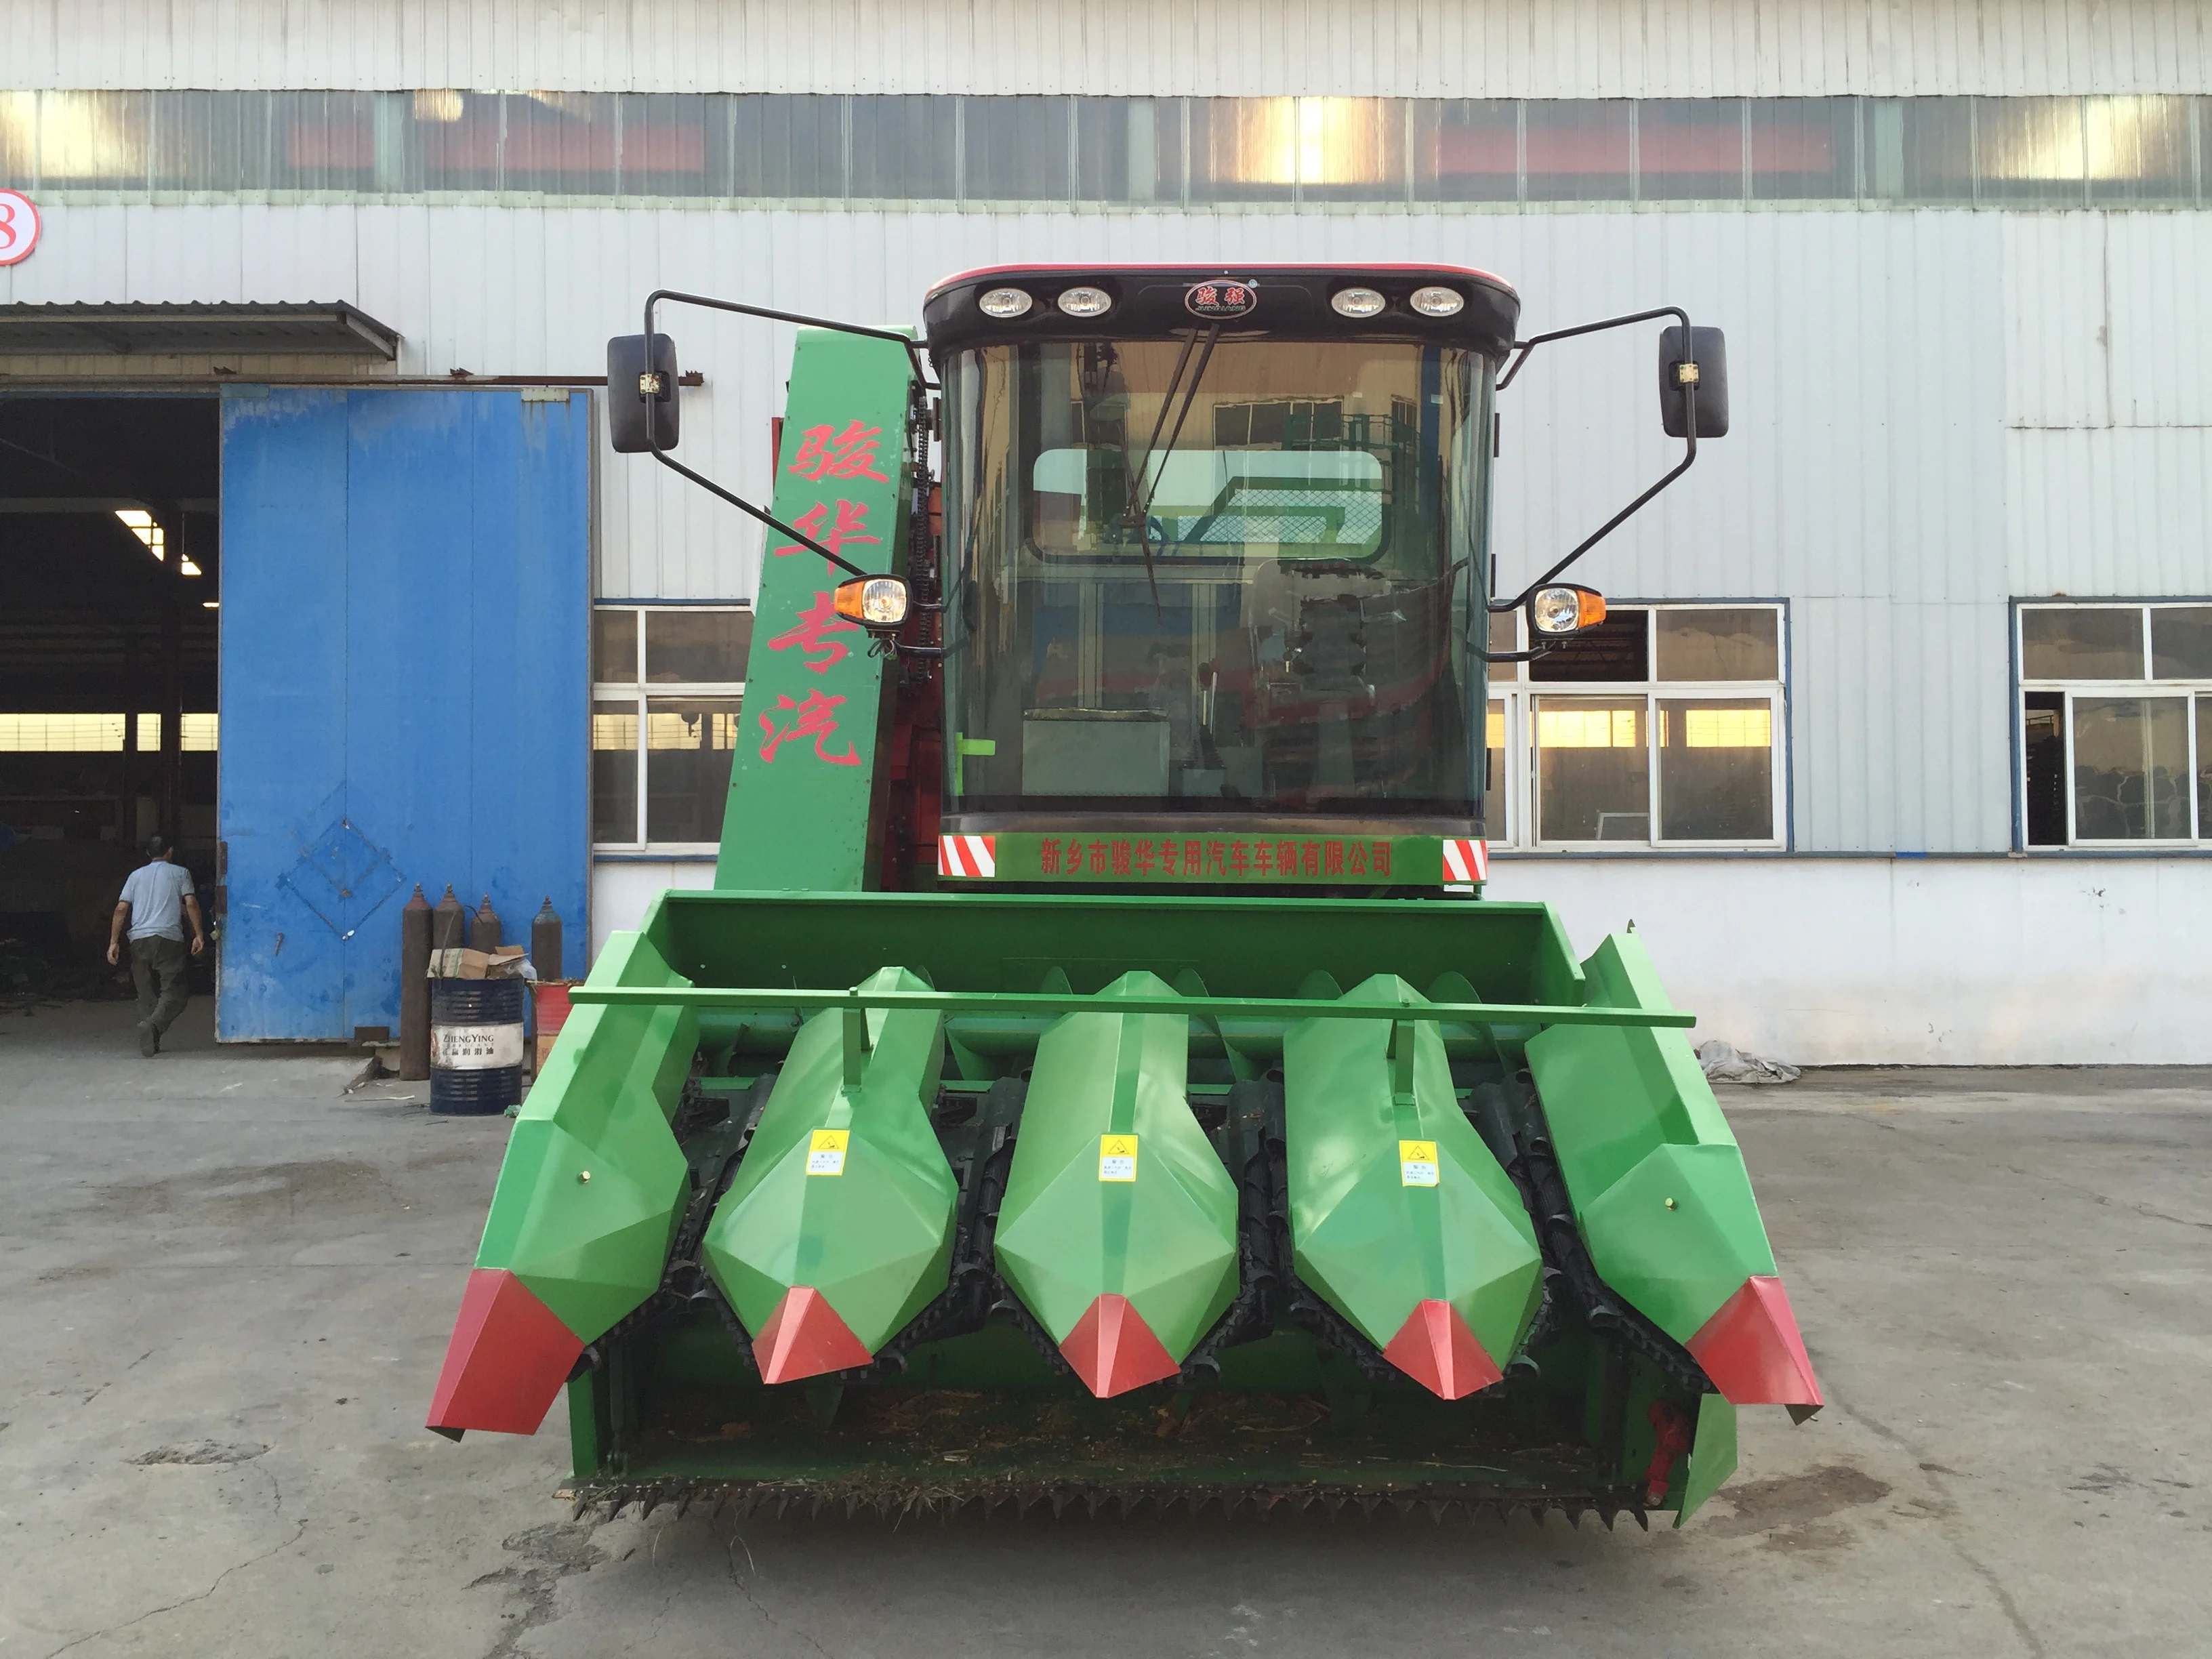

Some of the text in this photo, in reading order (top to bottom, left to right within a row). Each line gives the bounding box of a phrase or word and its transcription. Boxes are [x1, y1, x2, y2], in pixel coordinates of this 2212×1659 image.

[1195, 285, 1246, 306] 骏强
[758, 419, 890, 766] 骏华专汽
[1040, 838, 1391, 878] 新乡市骏华专用汽车车辆有限公司
